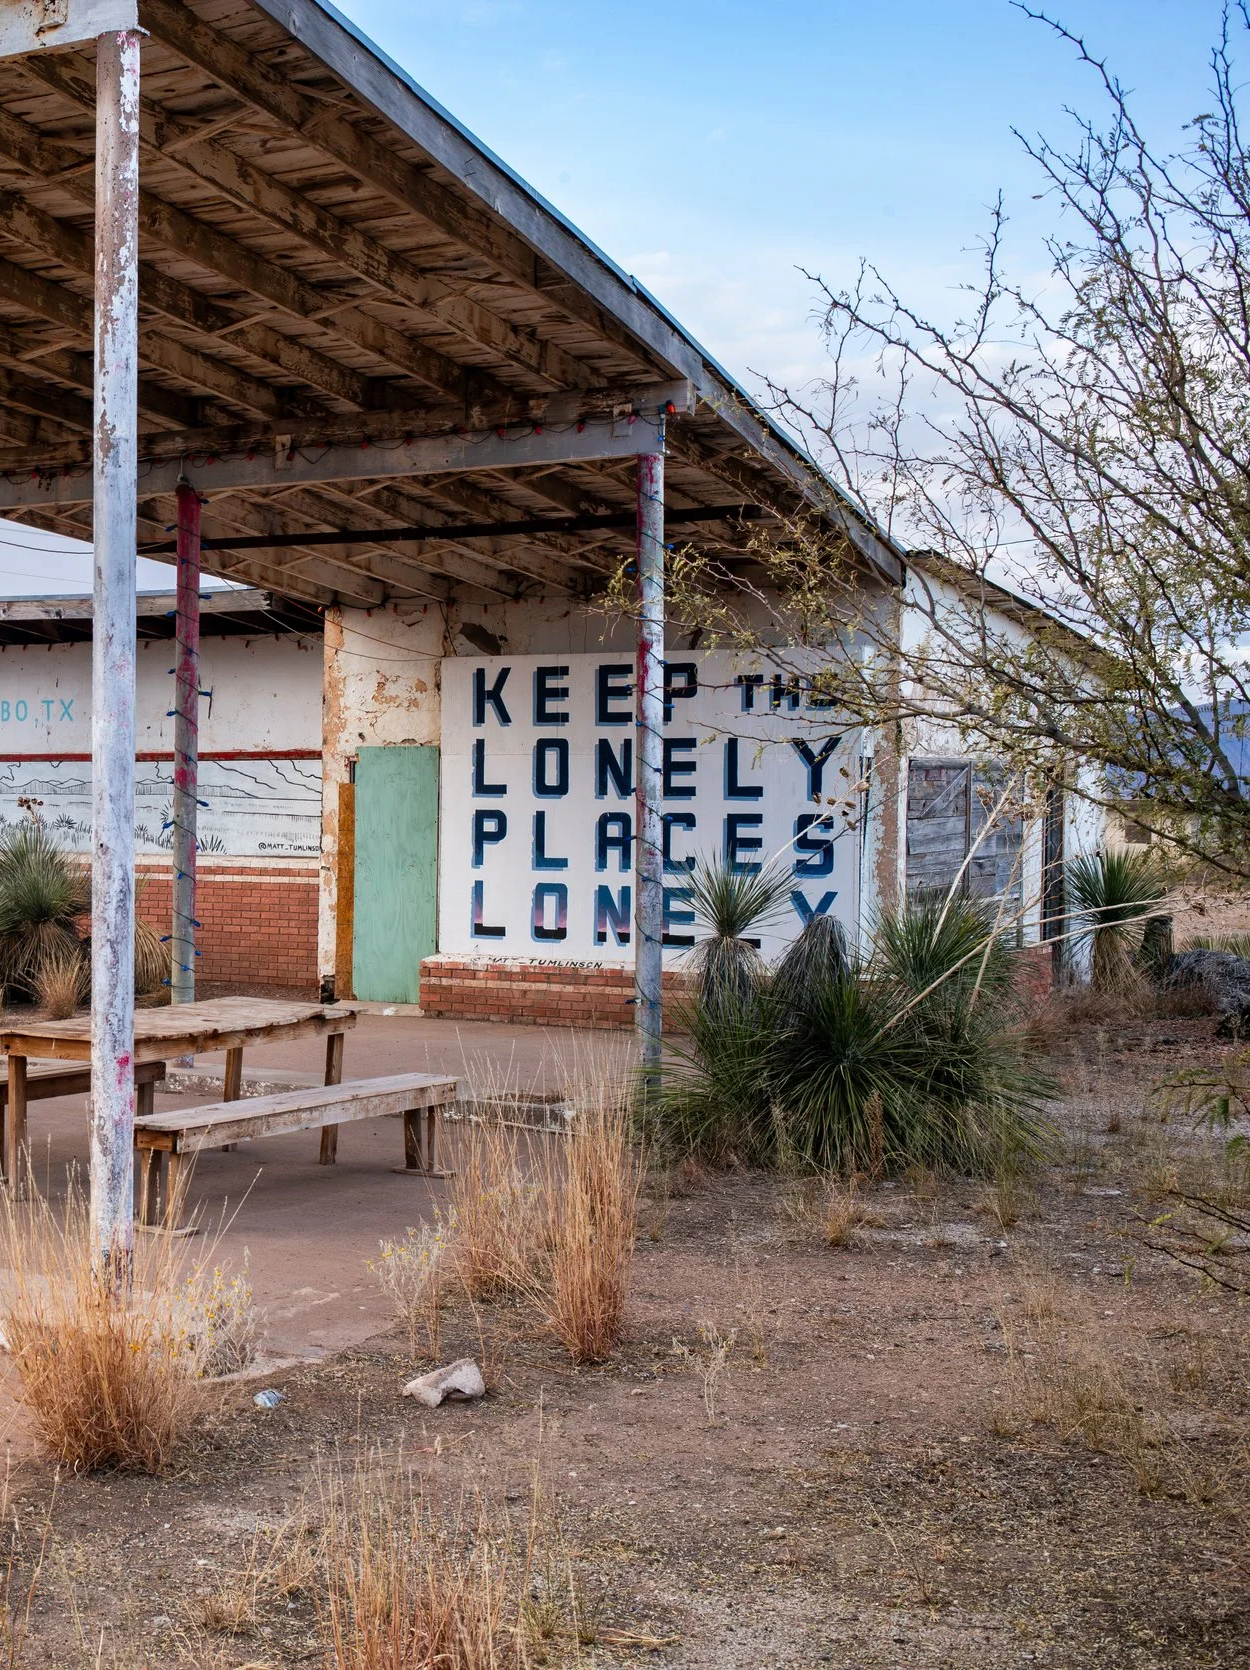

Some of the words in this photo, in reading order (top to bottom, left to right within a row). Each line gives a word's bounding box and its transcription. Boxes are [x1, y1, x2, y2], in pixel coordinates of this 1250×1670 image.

[41, 699, 74, 722] TX
[472, 662, 698, 727] KEEP
[472, 737, 842, 801] LONELY
[258, 842, 320, 852] @MATT_TUMLINSO
[471, 809, 835, 878] PLACES
[470, 879, 839, 950] LONEY
